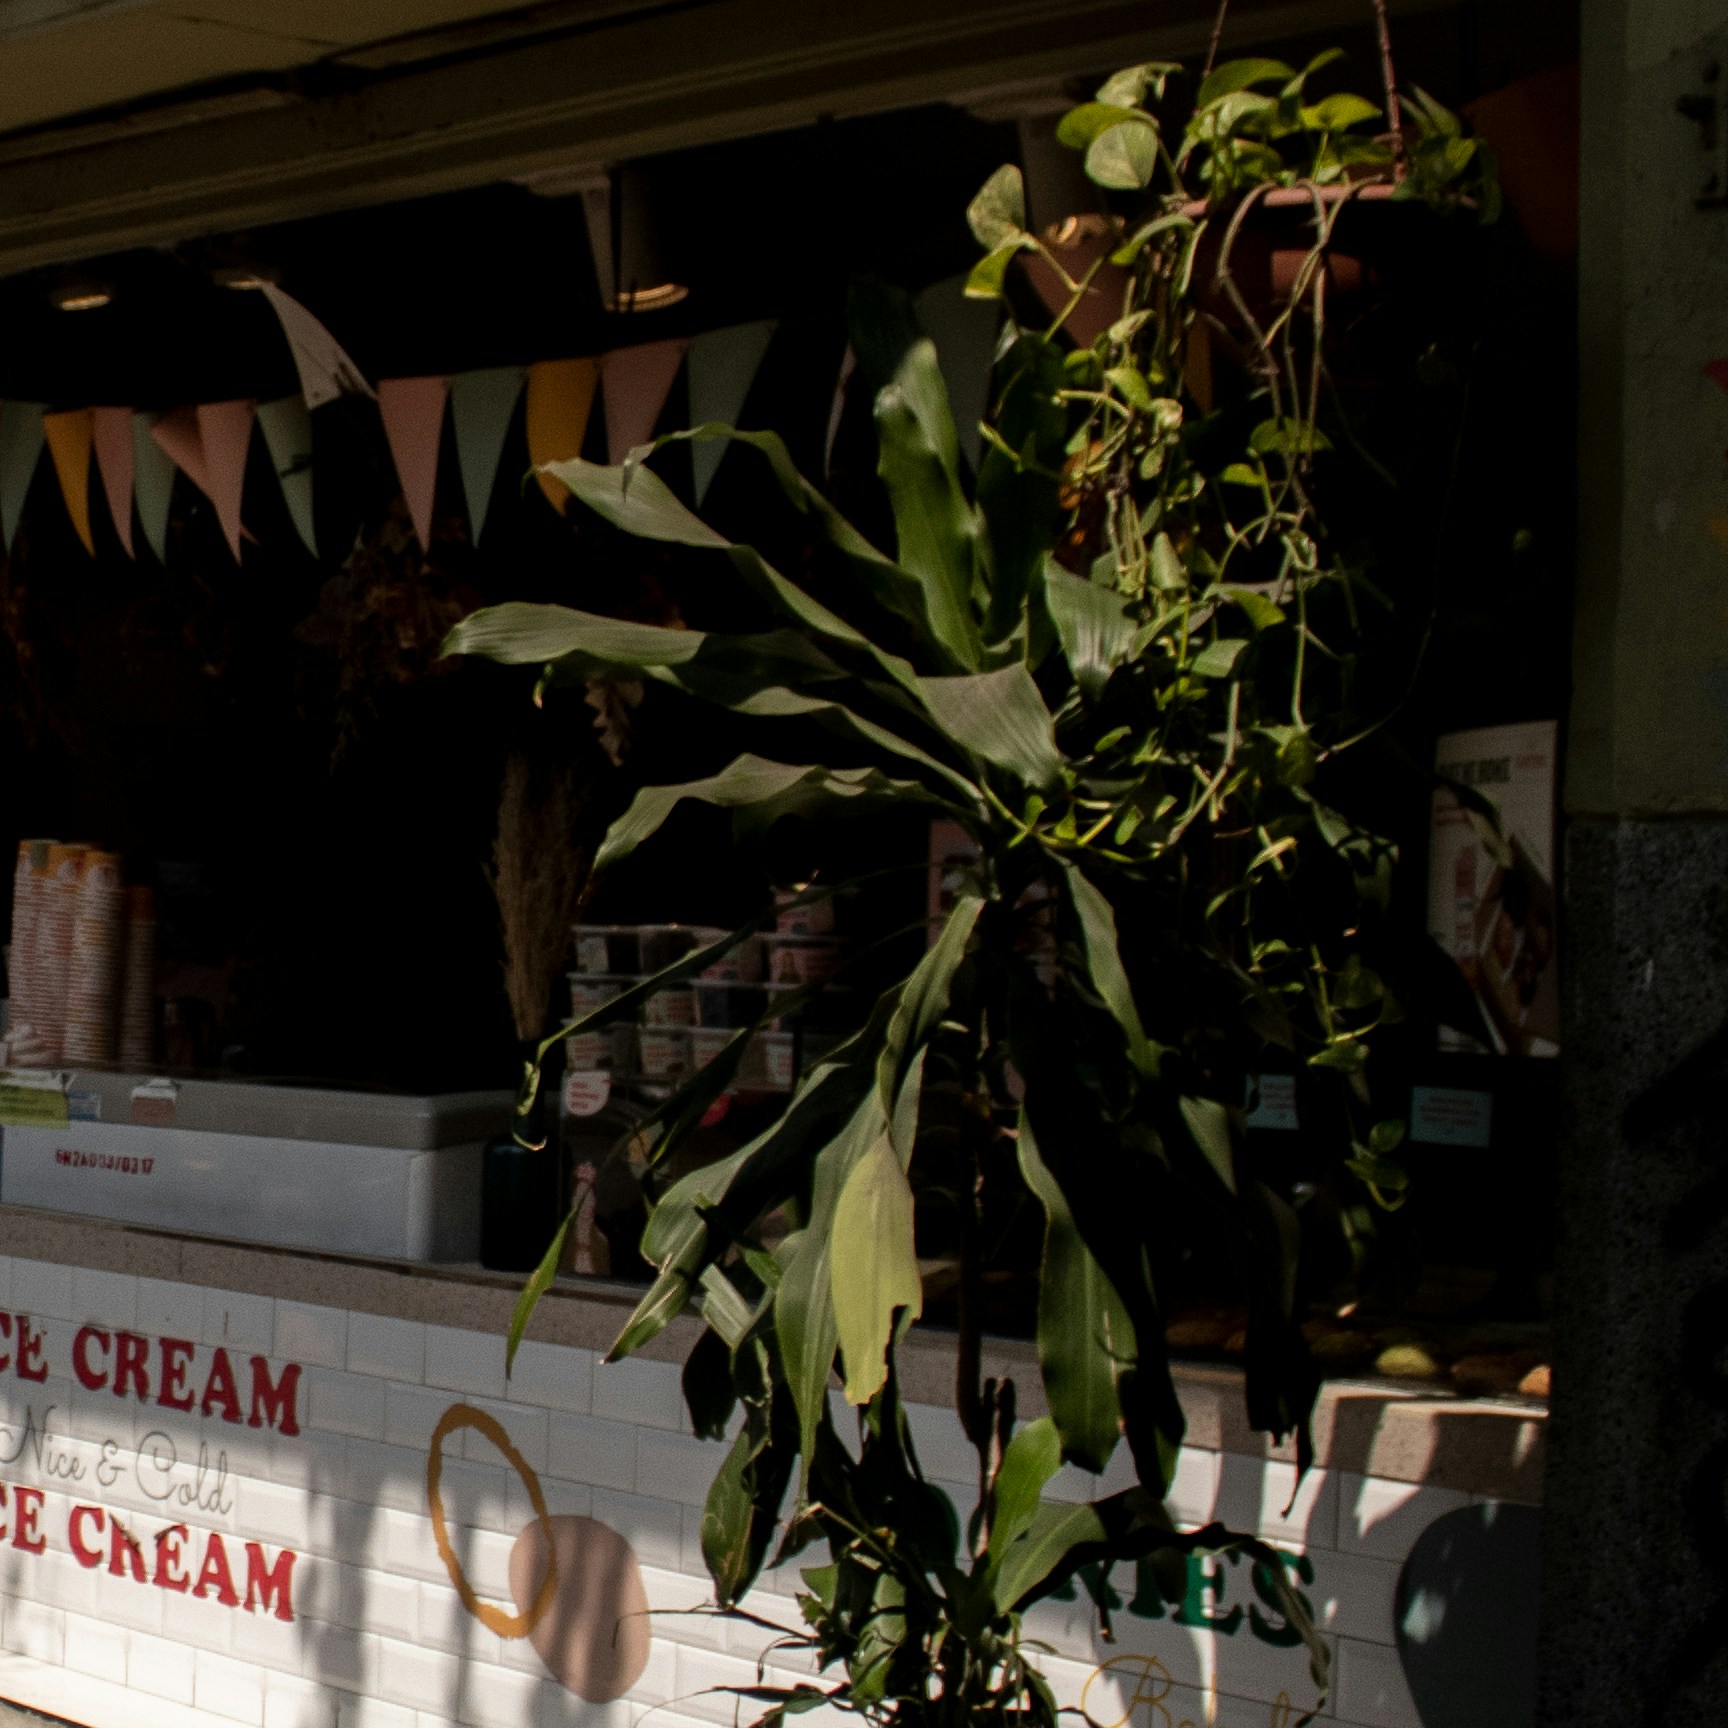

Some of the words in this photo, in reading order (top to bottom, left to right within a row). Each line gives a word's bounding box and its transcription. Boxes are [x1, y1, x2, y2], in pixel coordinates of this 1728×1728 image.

[72, 1324, 302, 1437] CREAM
[96, 1447, 128, 1487] &
[135, 1430, 236, 1516] Cold
[68, 1505, 298, 1622] CREAM
